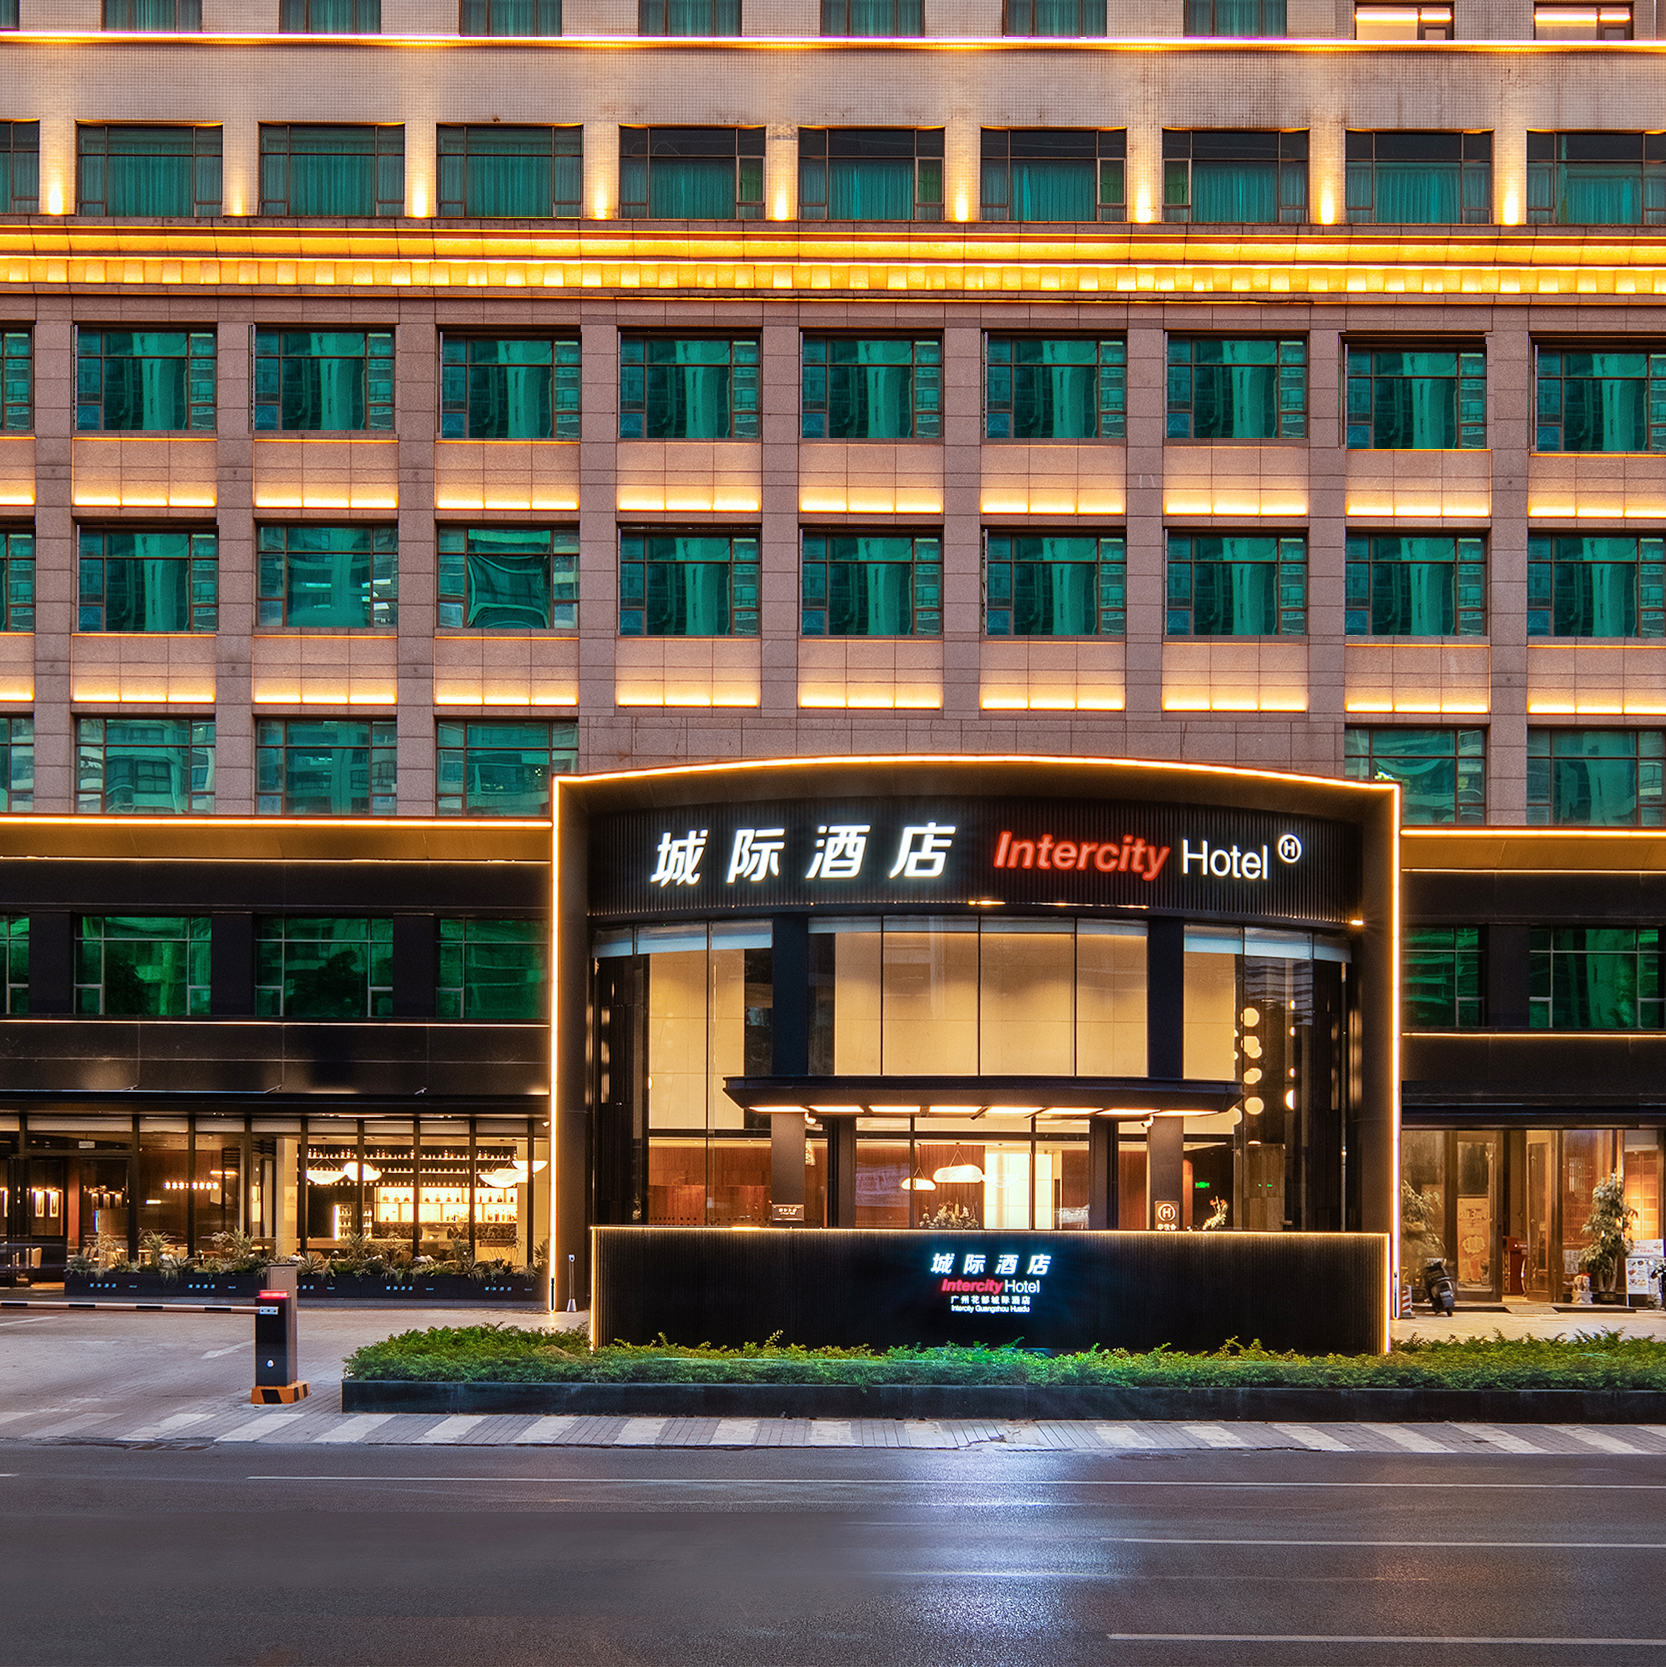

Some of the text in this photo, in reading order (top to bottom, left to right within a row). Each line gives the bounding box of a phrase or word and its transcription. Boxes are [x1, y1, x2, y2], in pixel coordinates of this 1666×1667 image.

[650, 821, 957, 887] 城际酒店
[993, 830, 1170, 882] Intercity
[1181, 838, 1270, 881] Hotel
[930, 1252, 1052, 1275] 城际酒店
[941, 1278, 1040, 1294] Intercity Hotel
[950, 1295, 1031, 1305] 广州花都城际酒店
[951, 1305, 1030, 1314] Intercity Guangzhou Huadu
